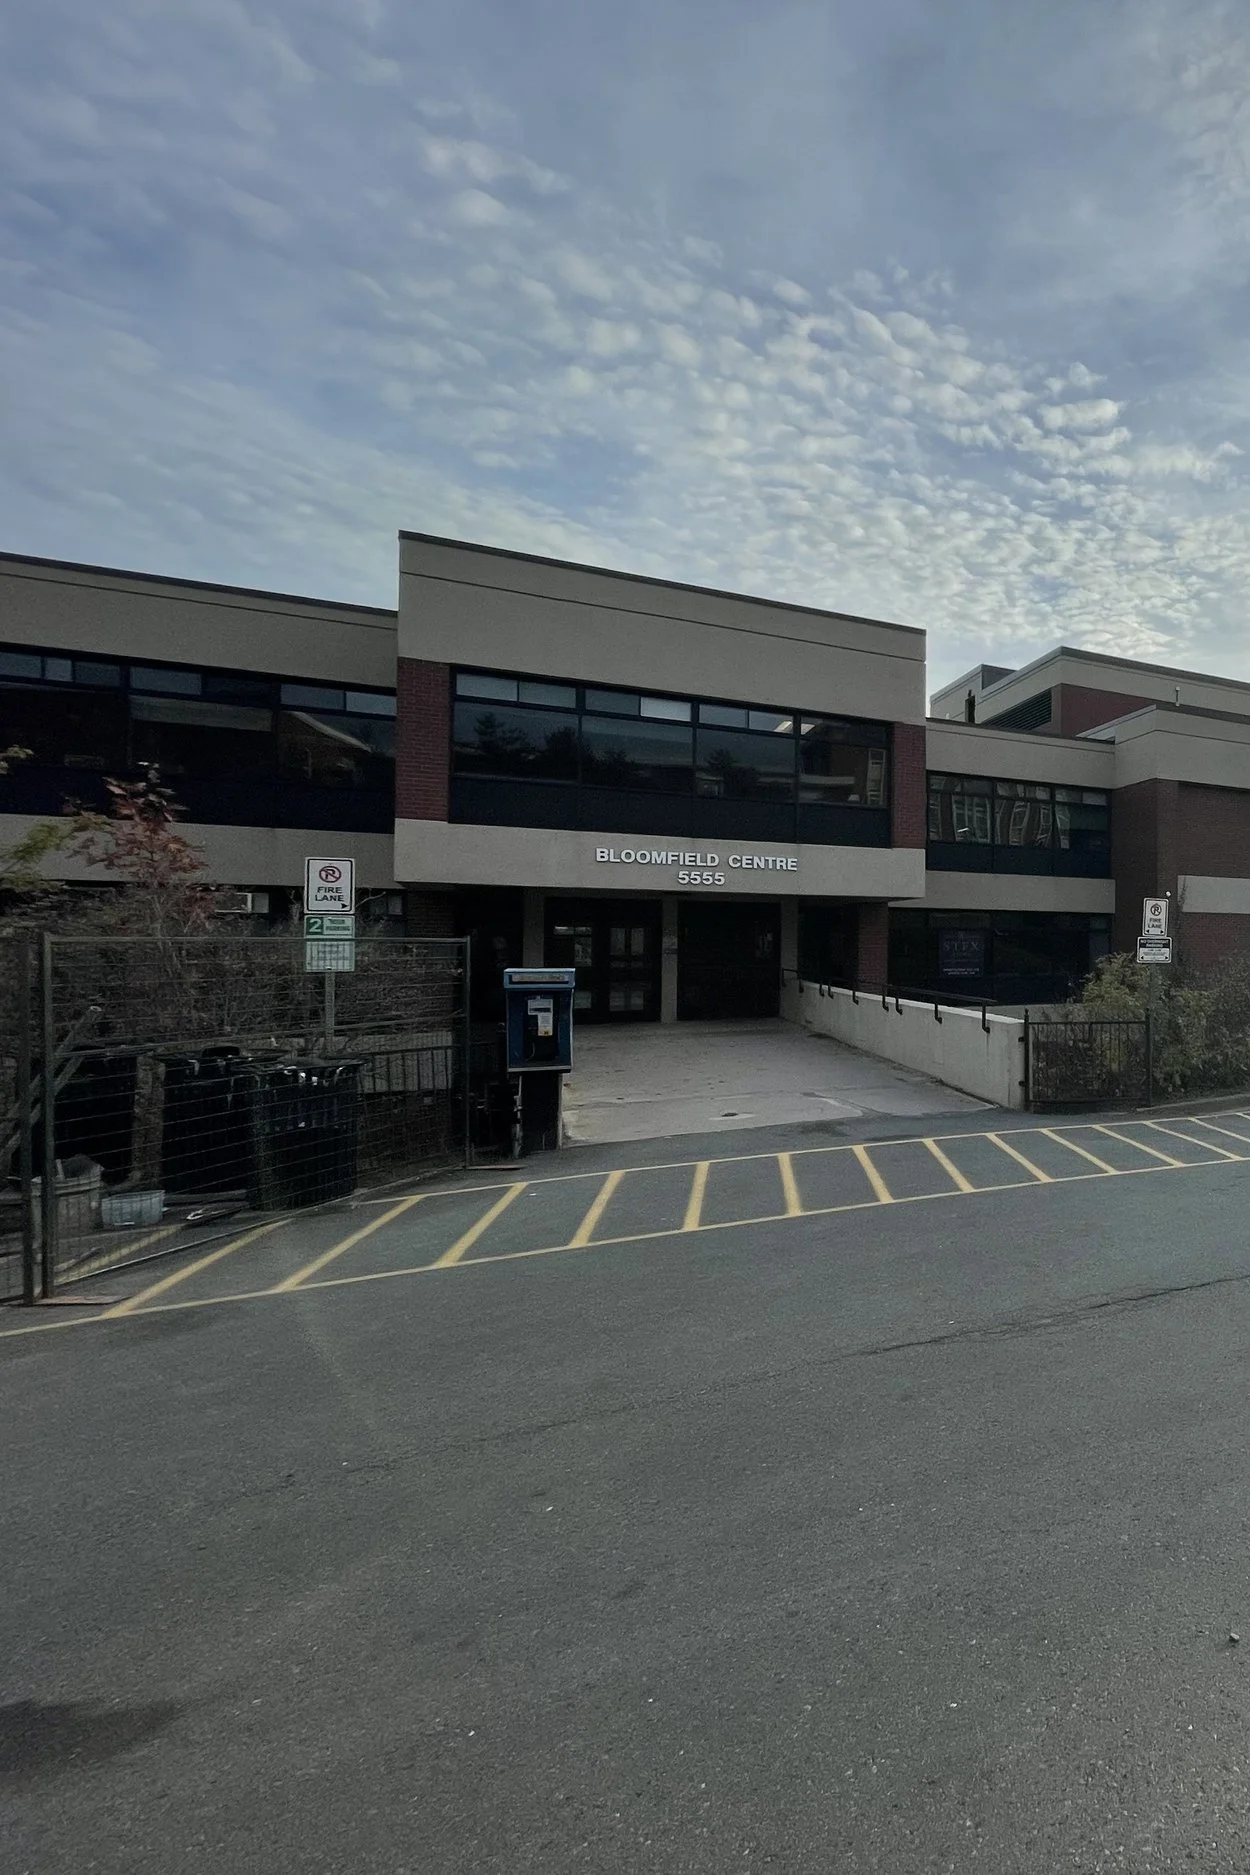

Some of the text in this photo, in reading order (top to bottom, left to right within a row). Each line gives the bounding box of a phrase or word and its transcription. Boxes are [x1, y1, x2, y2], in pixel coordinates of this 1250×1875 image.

[596, 847, 798, 872] BLOOMFIELD CENTRE
[677, 870, 726, 885] 5555
[309, 919, 322, 932] 2
